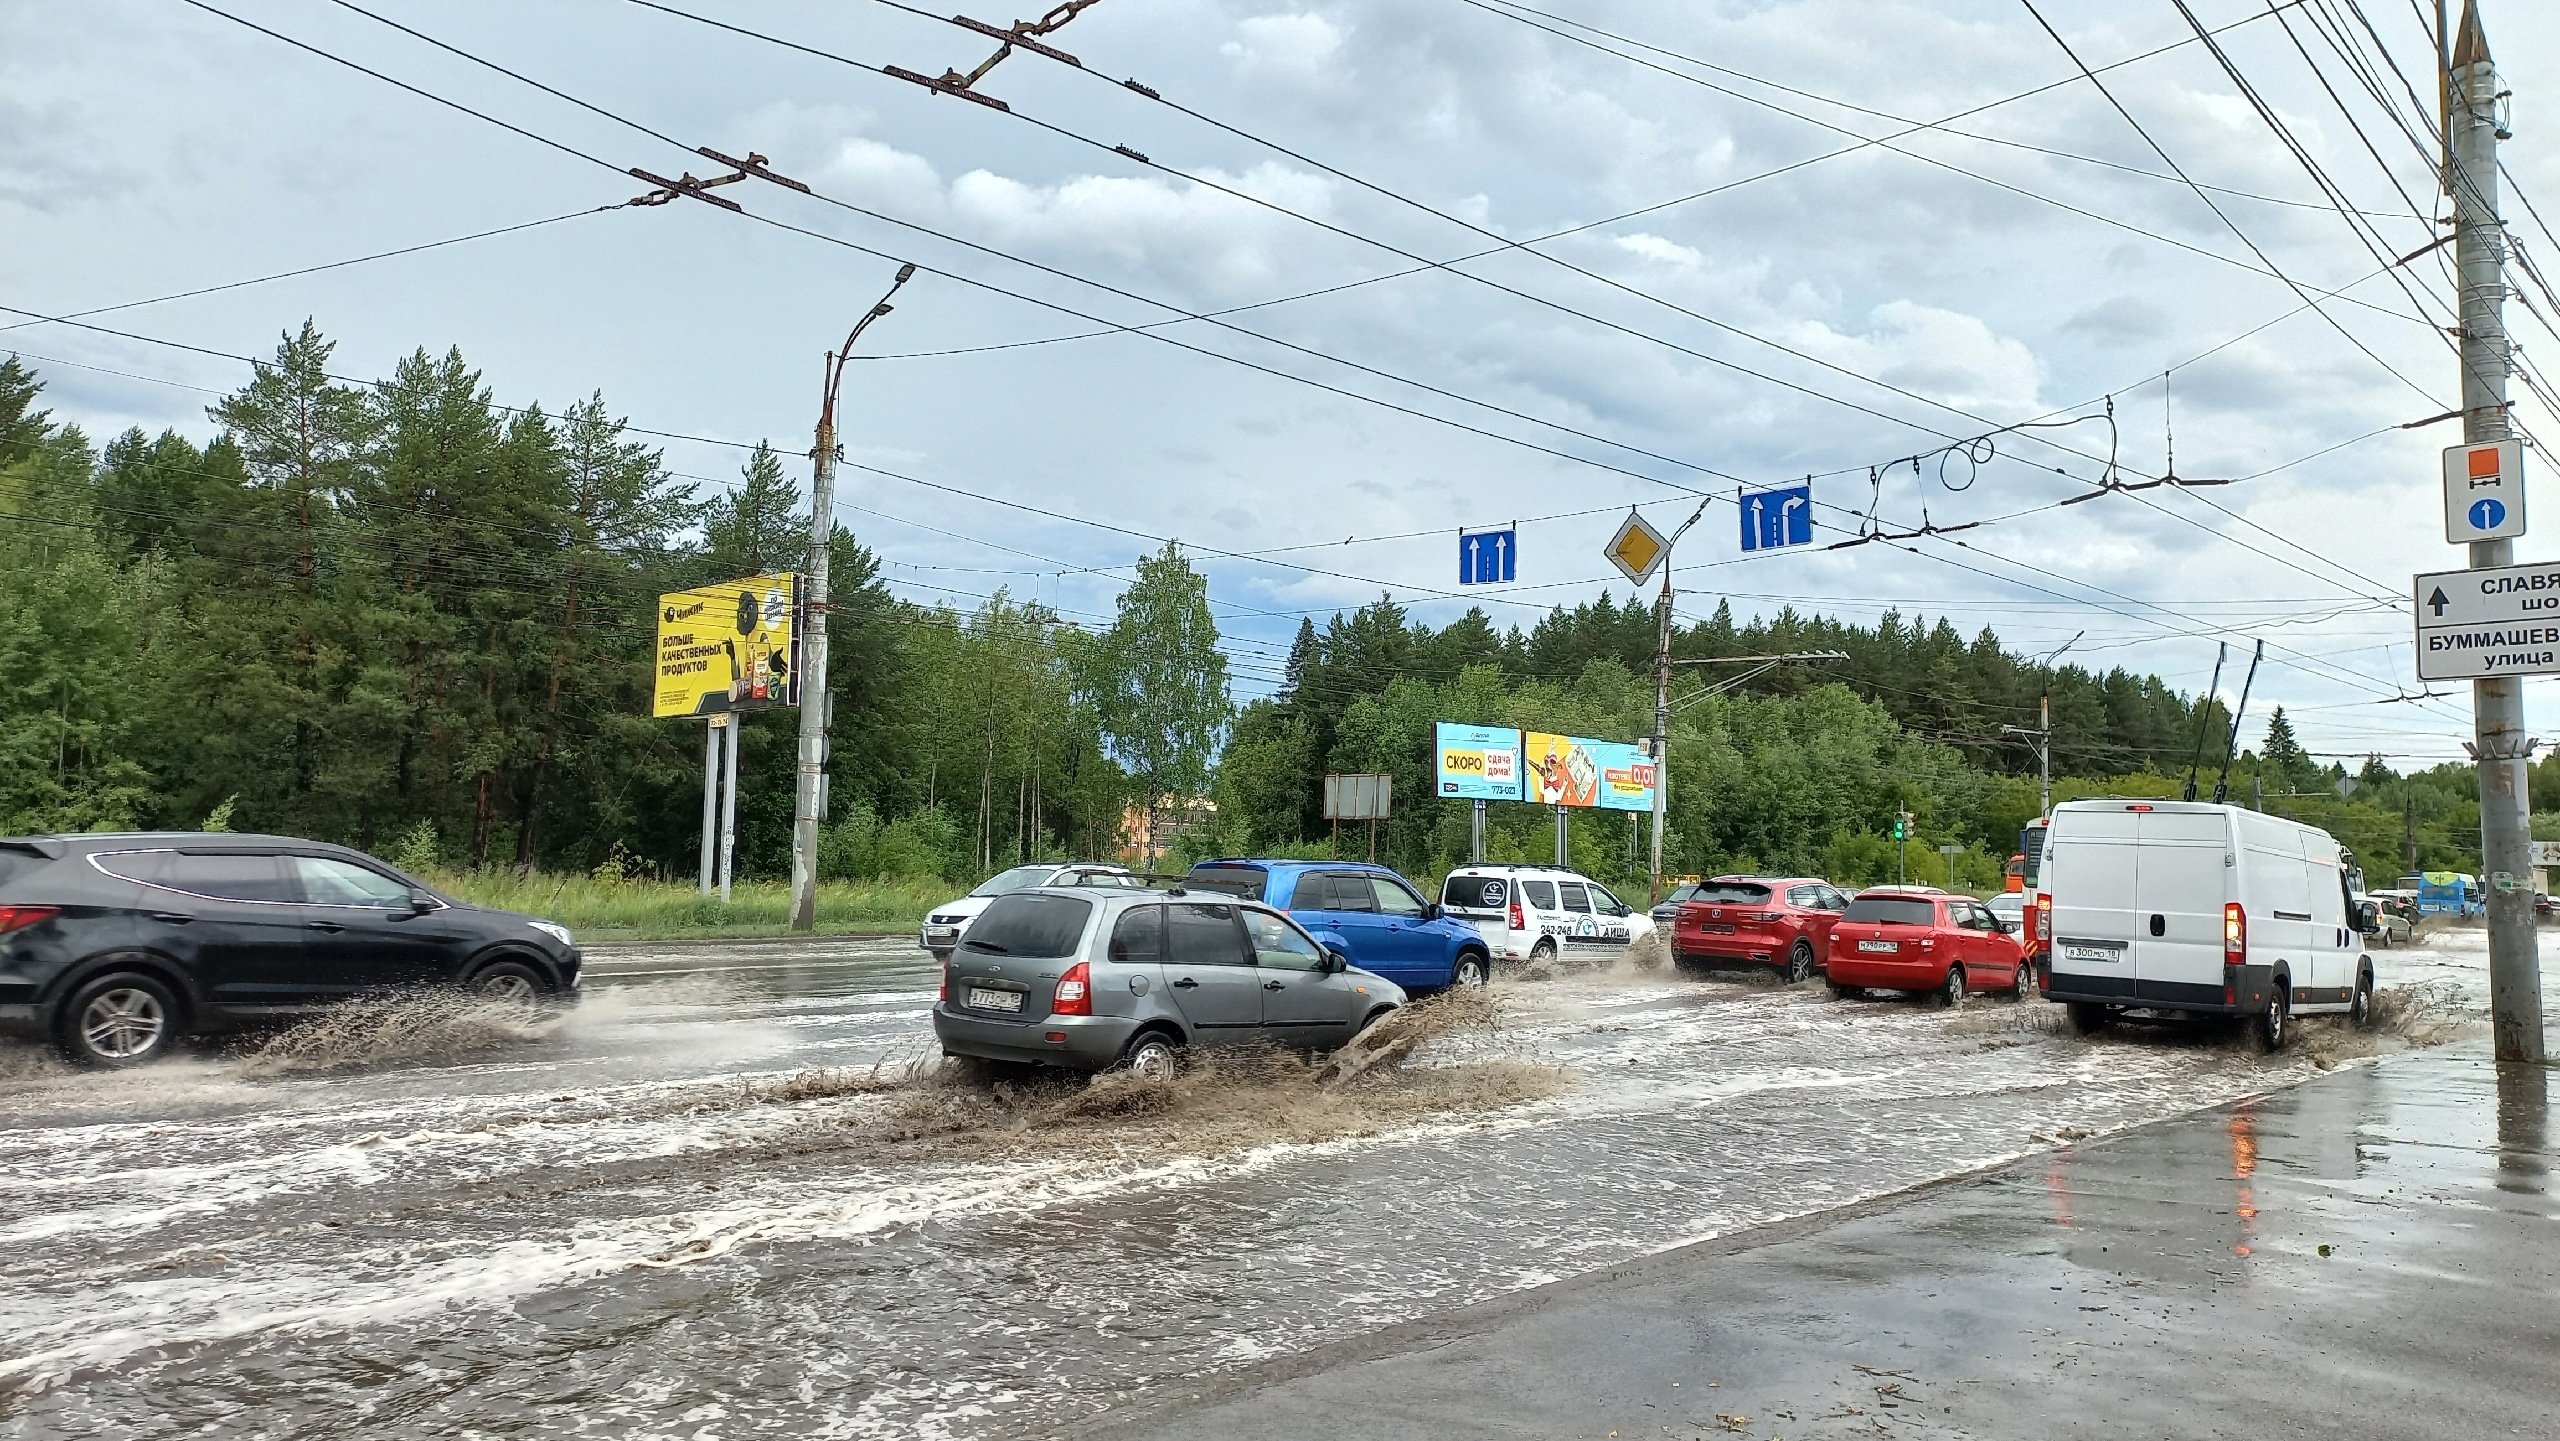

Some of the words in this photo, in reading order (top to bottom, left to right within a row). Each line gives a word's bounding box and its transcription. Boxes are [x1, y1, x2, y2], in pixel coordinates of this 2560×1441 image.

[2480, 573, 2560, 595] СЛАВЯ
[2521, 596, 2560, 611] шо
[662, 633, 694, 649] БОЛЬШЕ
[2429, 628, 2560, 651] БУММАШЕВ
[661, 641, 722, 662] КАЧЕСТВЕННЫХ
[661, 659, 708, 677] ПРОДУКТОВ
[2484, 651, 2555, 671] улица
[1446, 755, 1482, 770] СКОРО
[1487, 754, 1511, 765] сдача
[1487, 766, 1511, 777] дома!
[1540, 925, 1572, 936] 242-248
